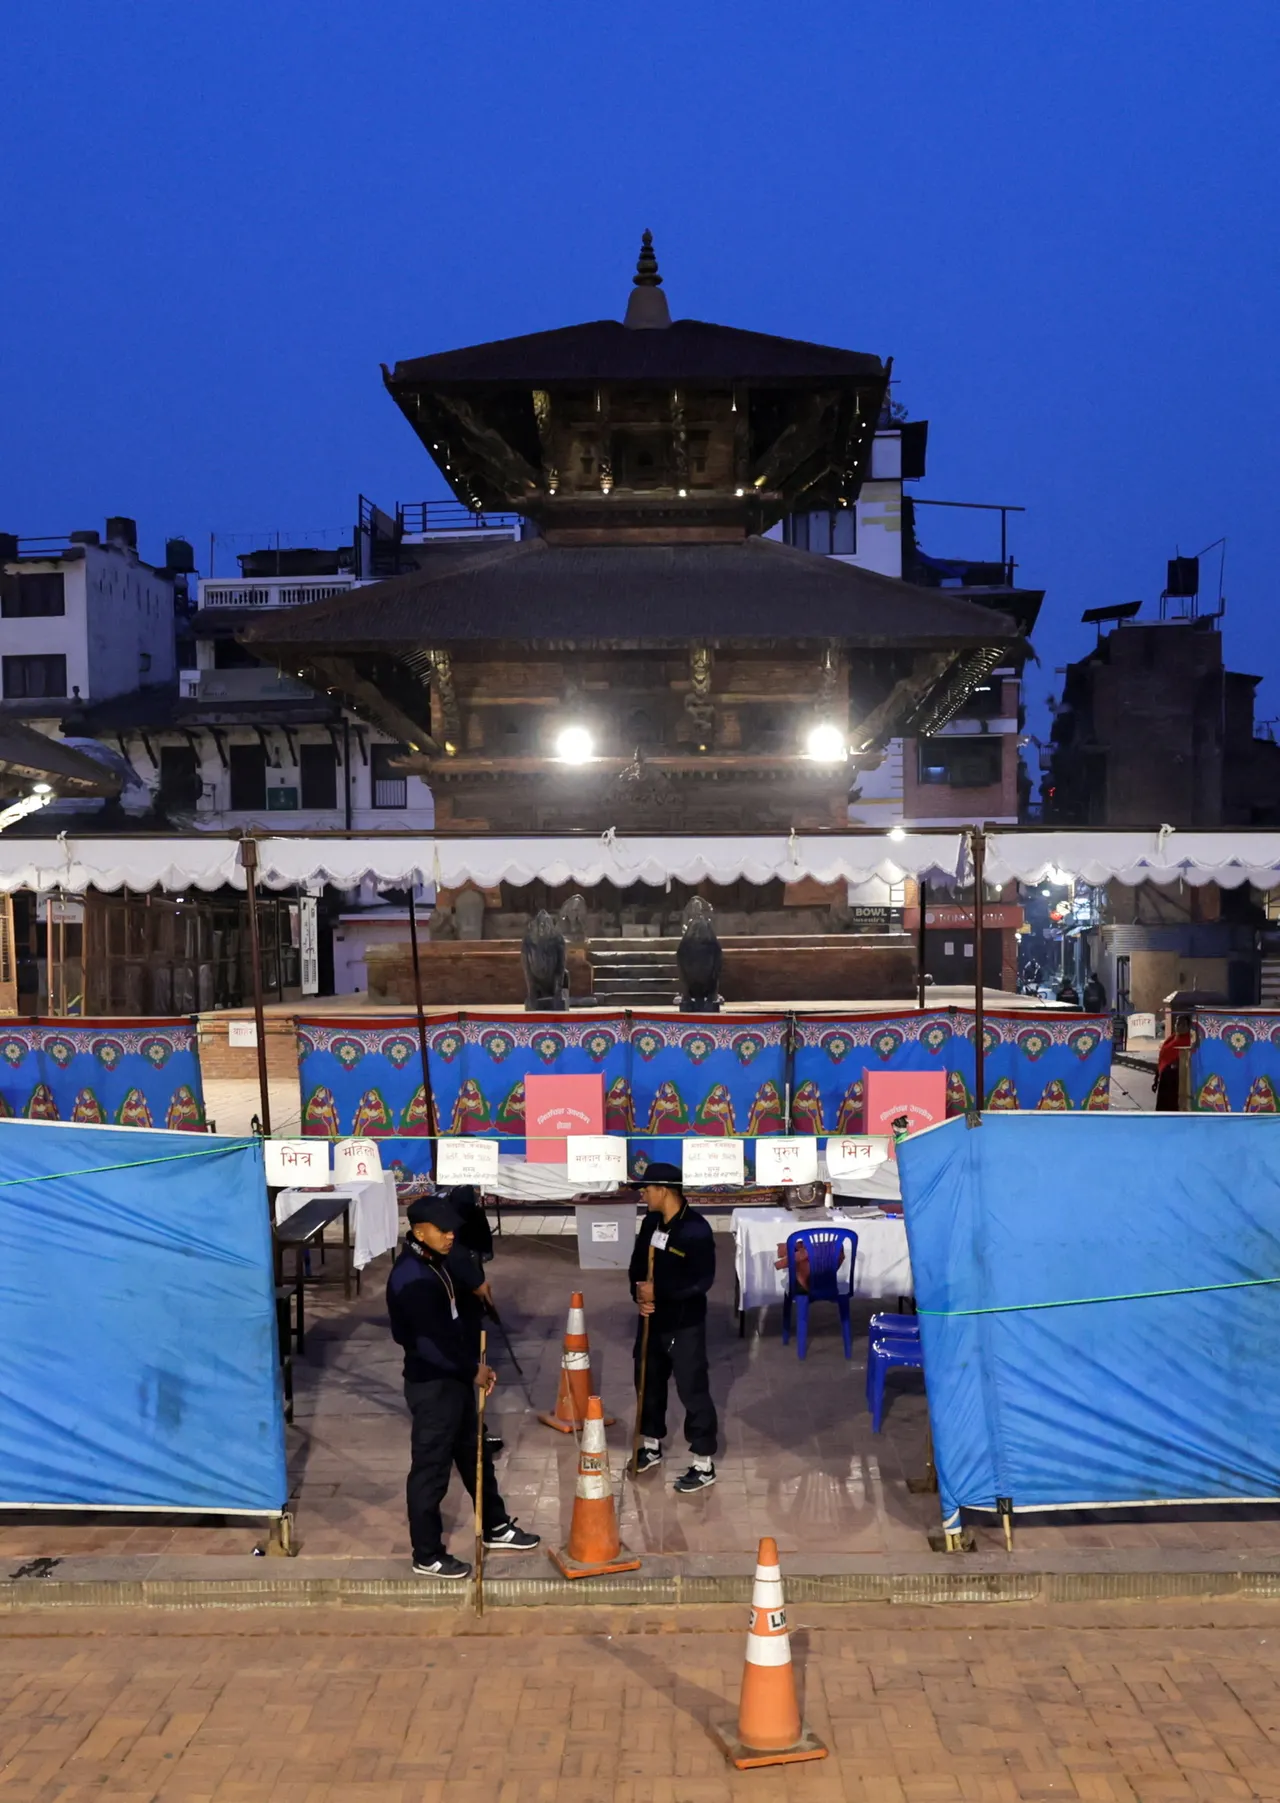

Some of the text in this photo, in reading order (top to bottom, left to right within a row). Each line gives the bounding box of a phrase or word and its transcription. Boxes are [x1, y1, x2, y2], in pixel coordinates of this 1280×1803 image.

[855, 907, 888, 917] BOWL
[280, 1146, 313, 1167] भित्र
[342, 1142, 375, 1158] महिला
[841, 1139, 873, 1158] भित्र
[575, 1154, 601, 1163] मतदान
[771, 1611, 786, 1628] LM
